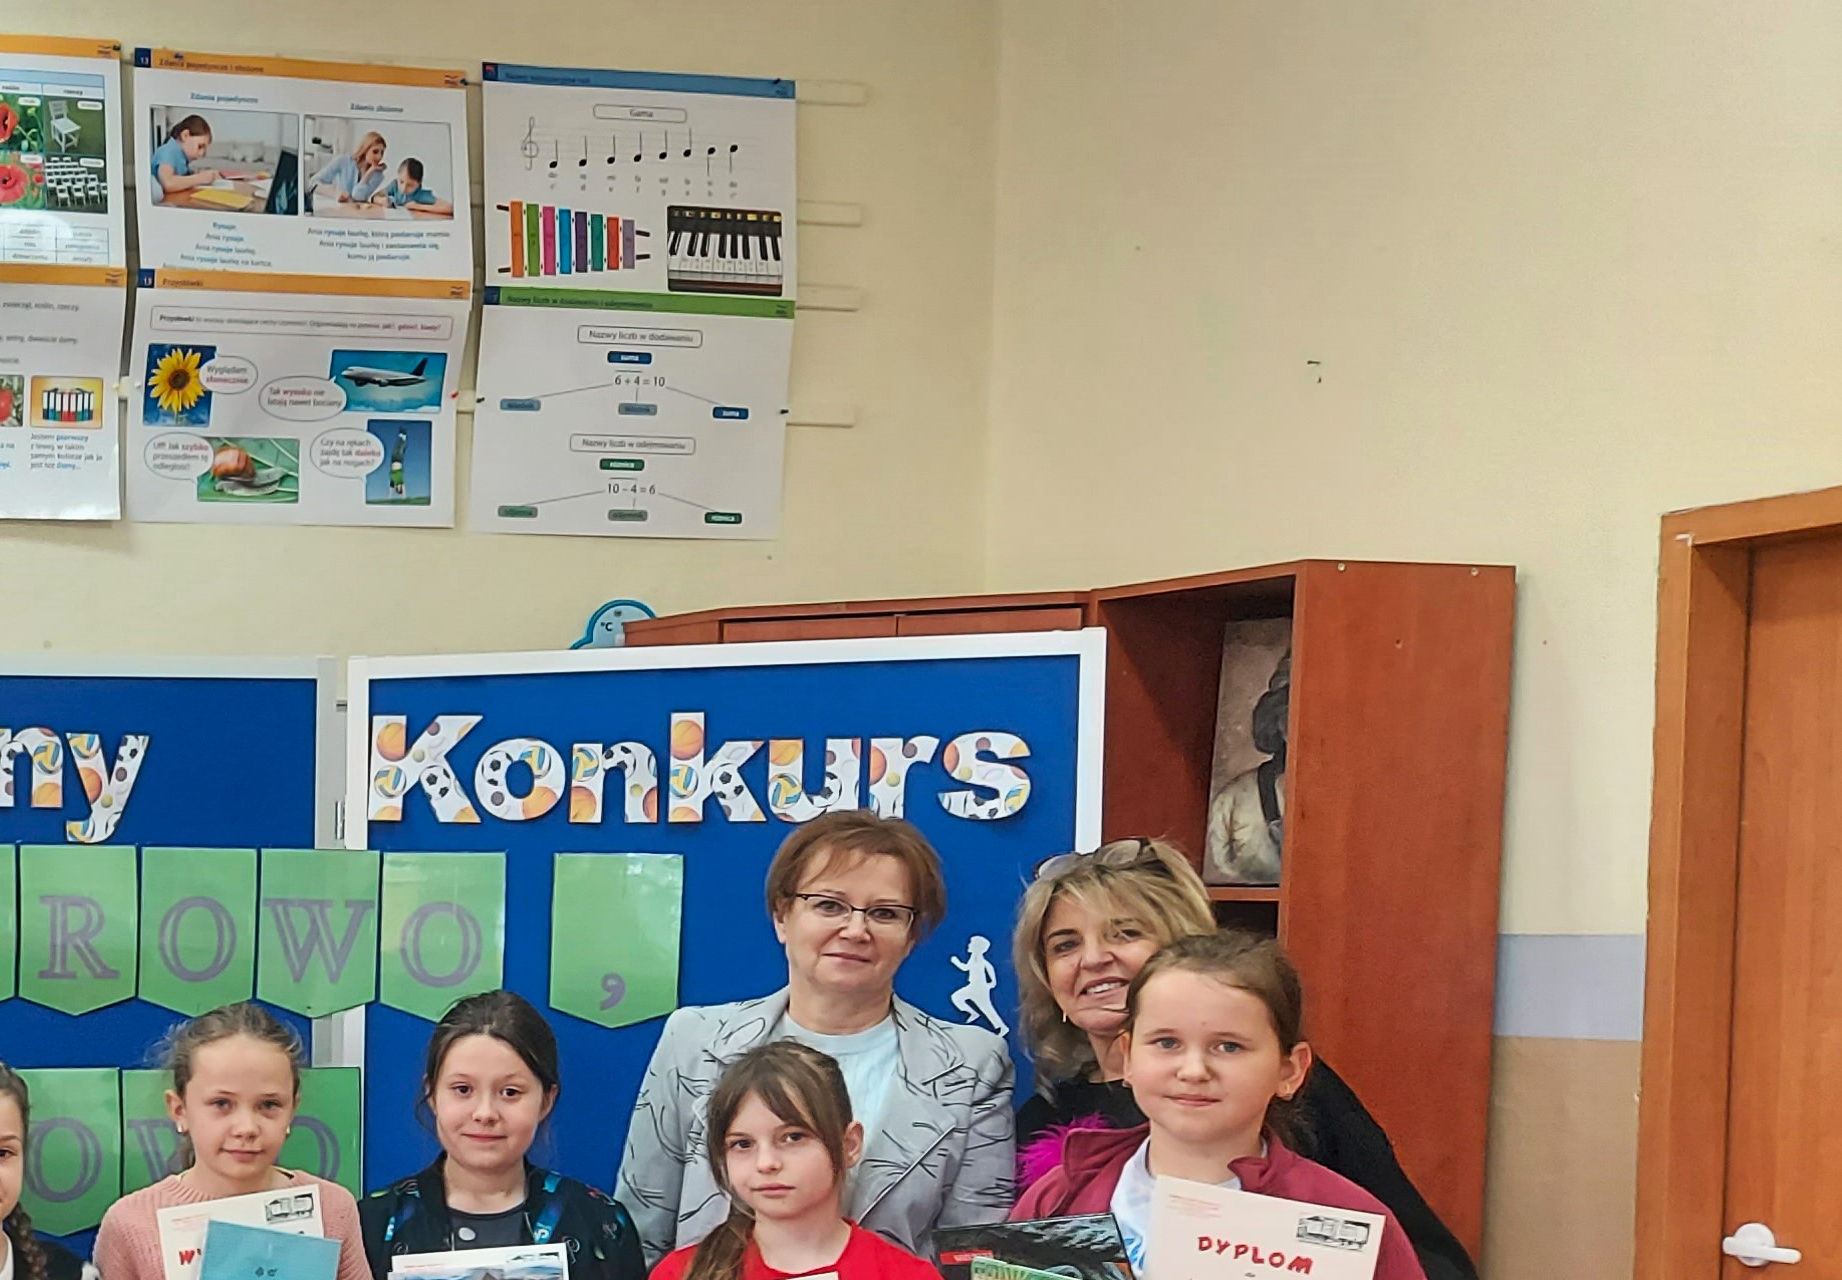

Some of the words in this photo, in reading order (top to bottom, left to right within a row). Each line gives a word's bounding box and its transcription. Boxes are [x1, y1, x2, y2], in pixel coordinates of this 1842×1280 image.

[588, 330, 617, 341] Nazwy
[618, 330, 638, 340] liczb
[614, 375, 622, 386] 6
[653, 375, 666, 387] 10
[607, 483, 620, 494] 10
[649, 483, 656, 495] 6
[367, 711, 1033, 824] Konkurs
[1198, 1235, 1314, 1275] DYPLOM
